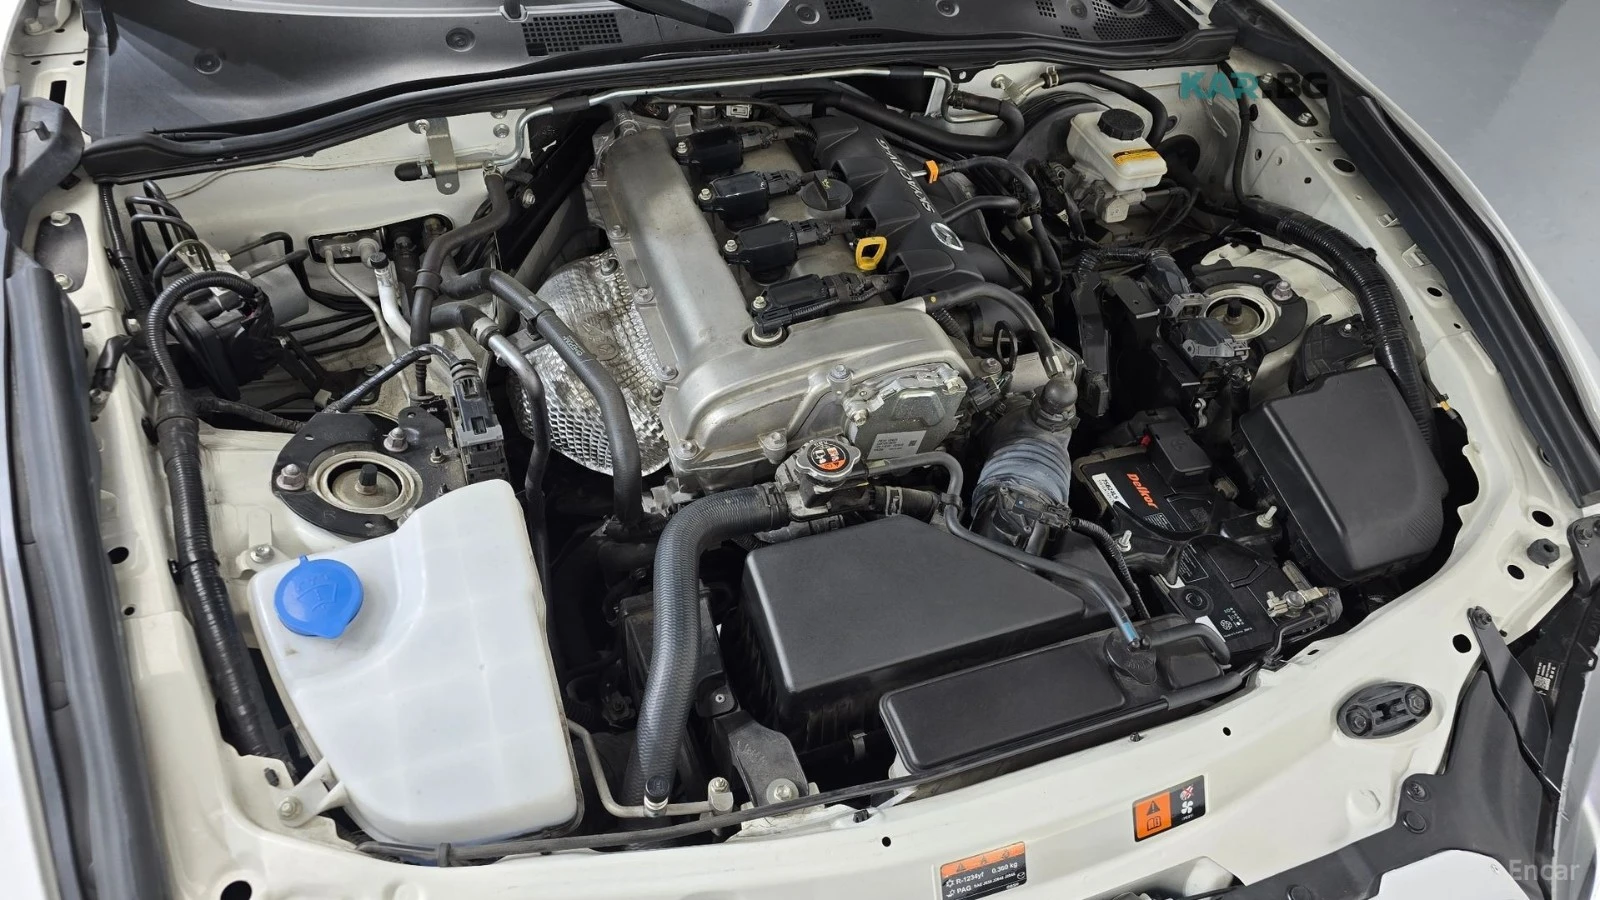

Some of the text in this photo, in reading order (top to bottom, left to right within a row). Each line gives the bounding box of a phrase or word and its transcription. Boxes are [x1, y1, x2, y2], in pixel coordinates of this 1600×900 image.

[1126, 473, 1159, 509] Delkor
[956, 871, 984, 884] R-1234yf
[956, 885, 972, 894] PAG
